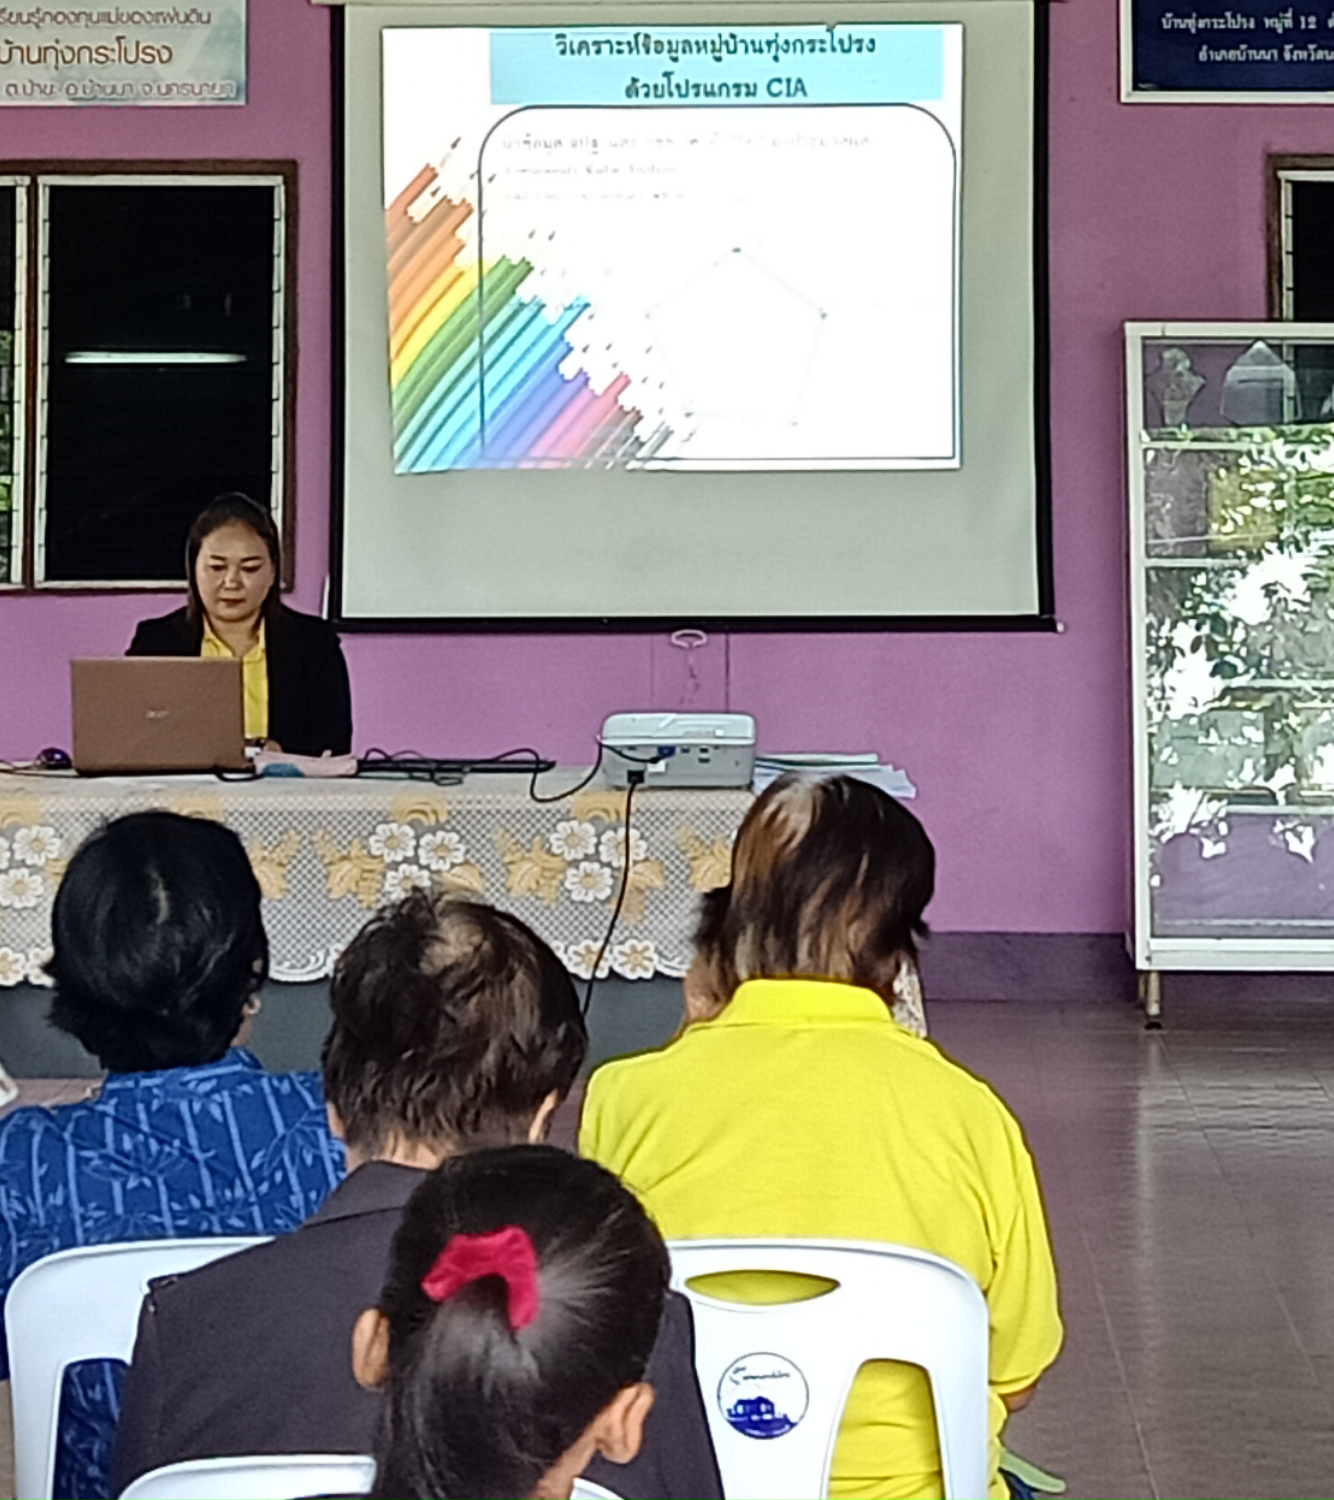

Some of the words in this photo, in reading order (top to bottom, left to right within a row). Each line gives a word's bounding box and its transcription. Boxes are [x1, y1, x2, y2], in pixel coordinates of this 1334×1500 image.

[1161, 11, 1256, 34] บ้านทุ่งกระโปรง
[1263, 8, 1293, 34] หมู่ที่
[1300, 16, 1317, 30] 12
[555, 28, 877, 64] วิเคราะห์ข้อมูลหมู่บ้านทุ่งกระโปรง
[1198, 44, 1279, 62] อำเภอบ้านนา
[624, 73, 758, 100] ด้วยโปรแกรม
[766, 77, 808, 99] CIA
